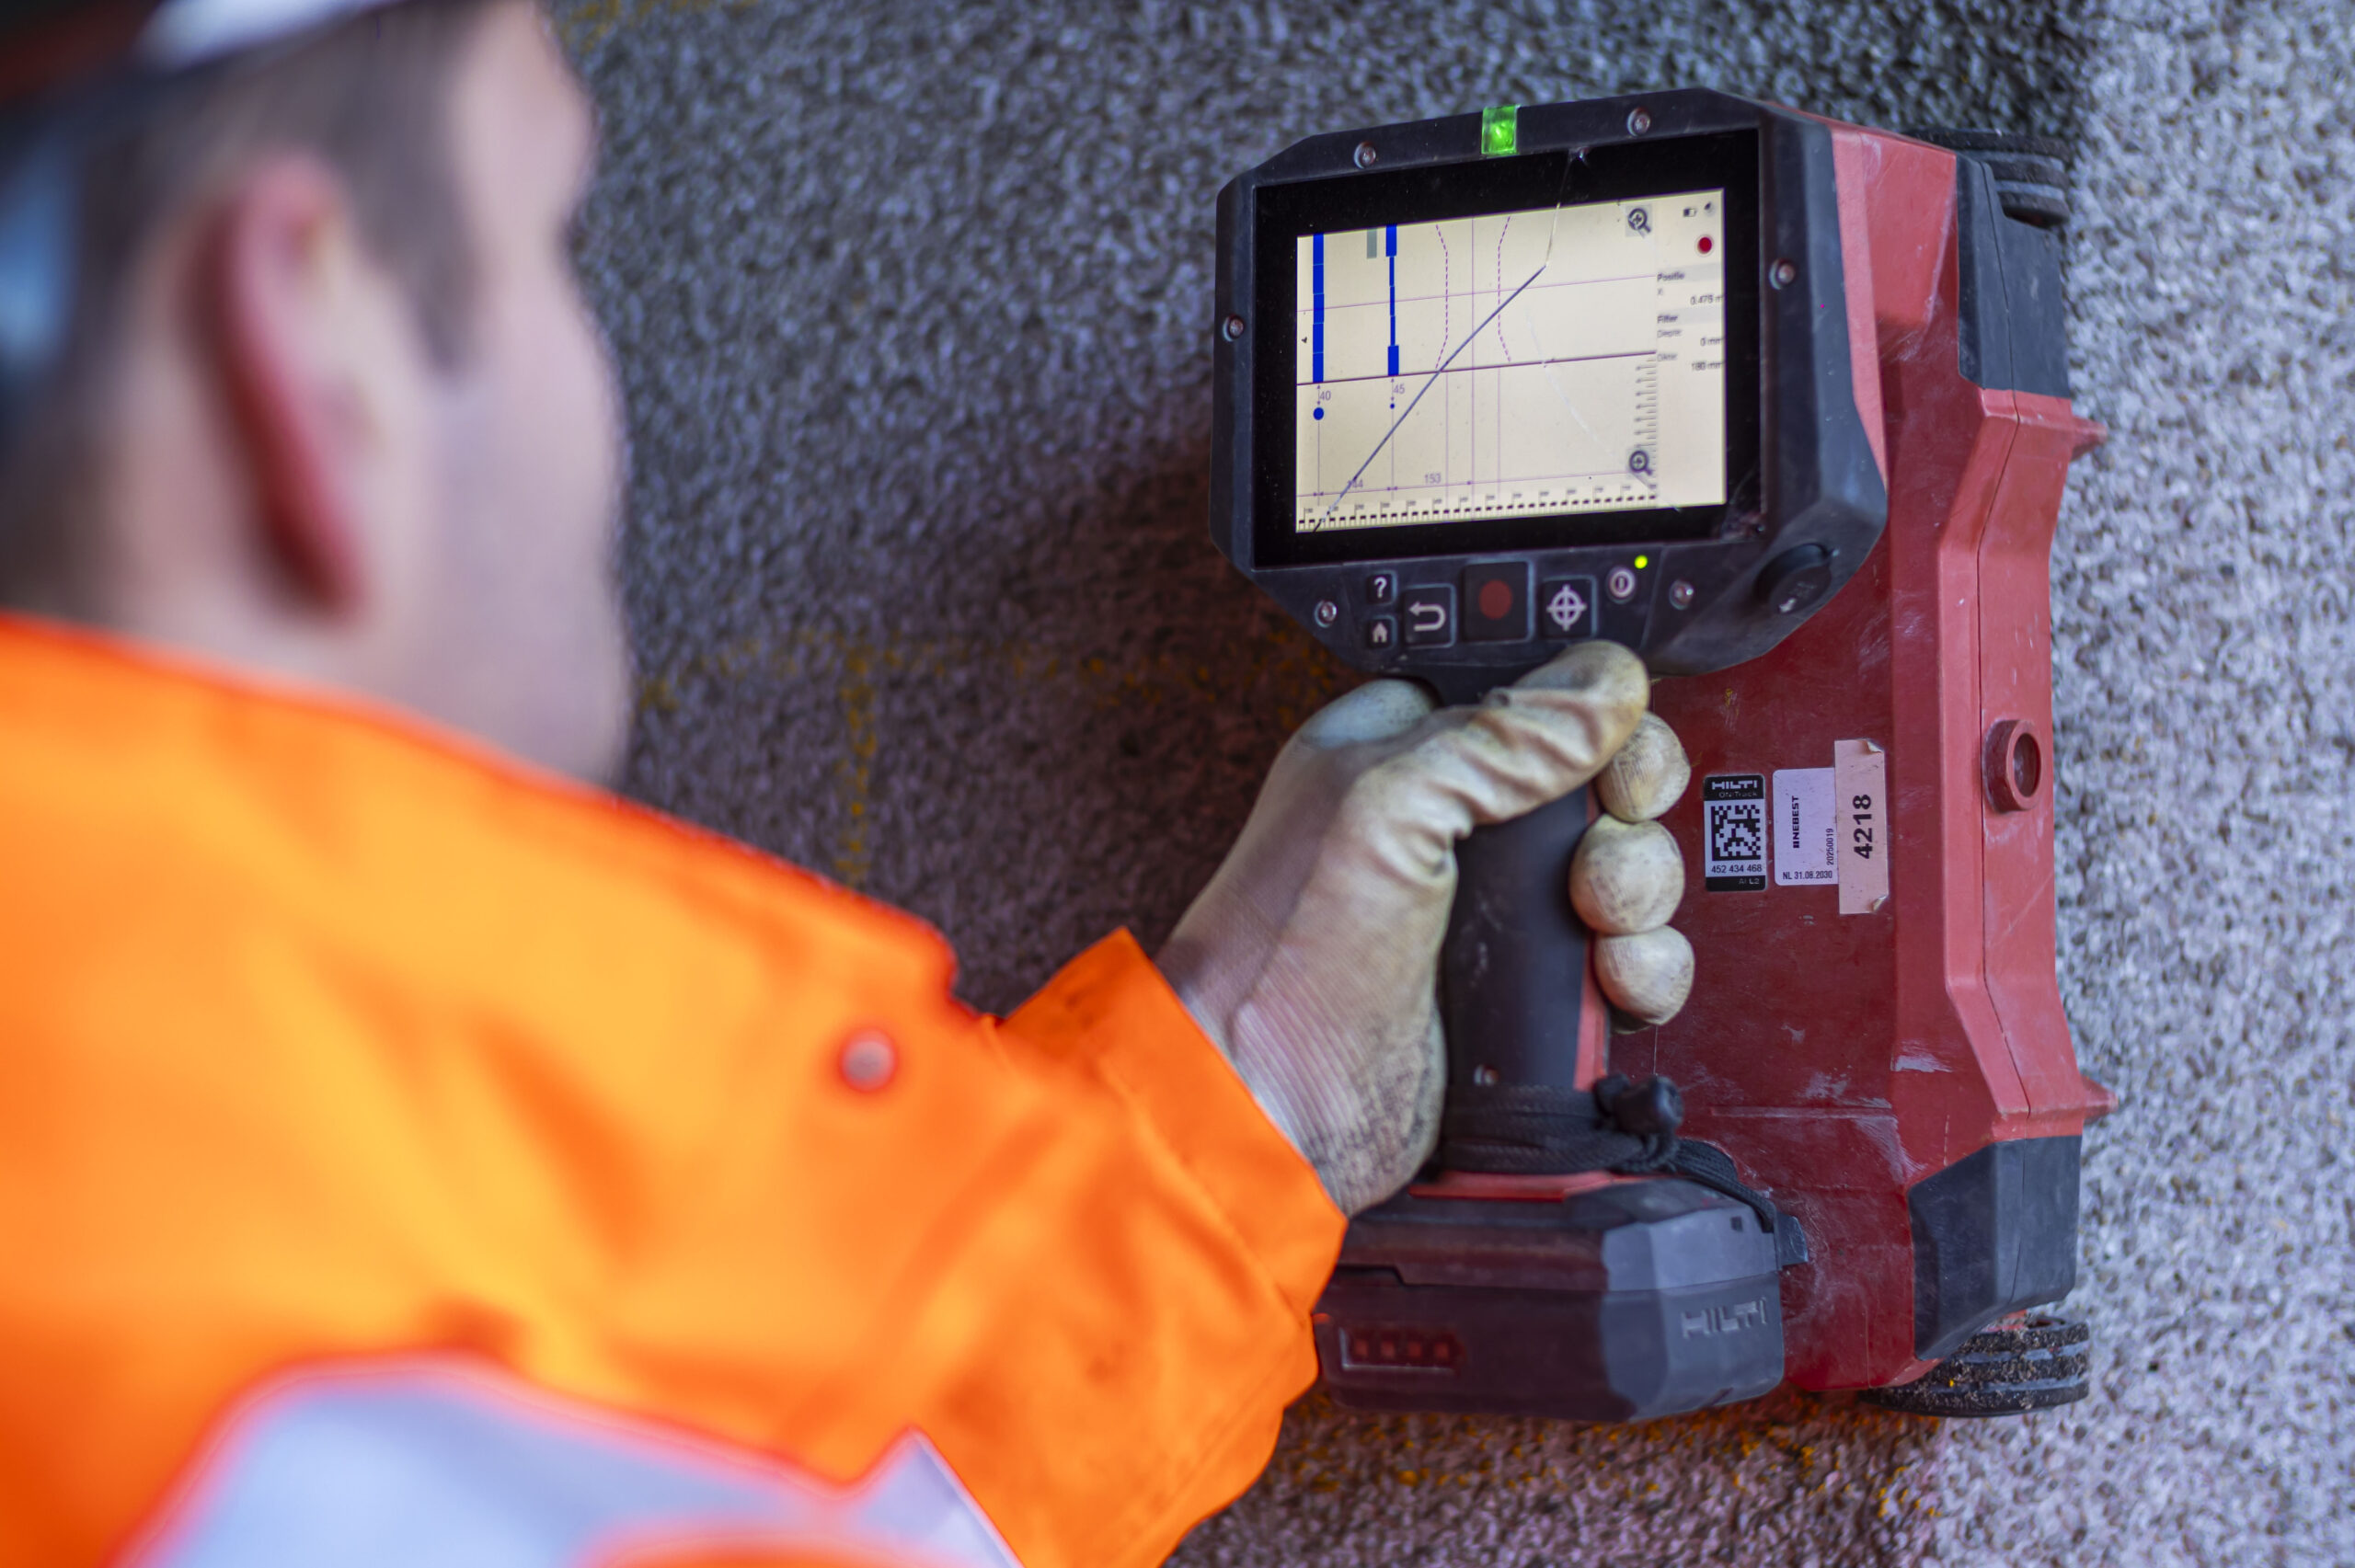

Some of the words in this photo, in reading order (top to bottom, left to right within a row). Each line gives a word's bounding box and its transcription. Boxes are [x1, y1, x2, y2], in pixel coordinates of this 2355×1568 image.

[1393, 383, 1406, 395] 45
[1319, 390, 1332, 402] 40
[1425, 472, 1442, 484] 153
[1711, 780, 1758, 791] HILTI
[1852, 794, 1874, 860] 4218
[1711, 864, 1727, 874] 452
[1729, 864, 1744, 873] 434
[1747, 864, 1763, 873] 468
[1782, 871, 1793, 880] NL
[1794, 870, 1833, 880] 31.08.2030
[1681, 1295, 1767, 1340] HILTI
